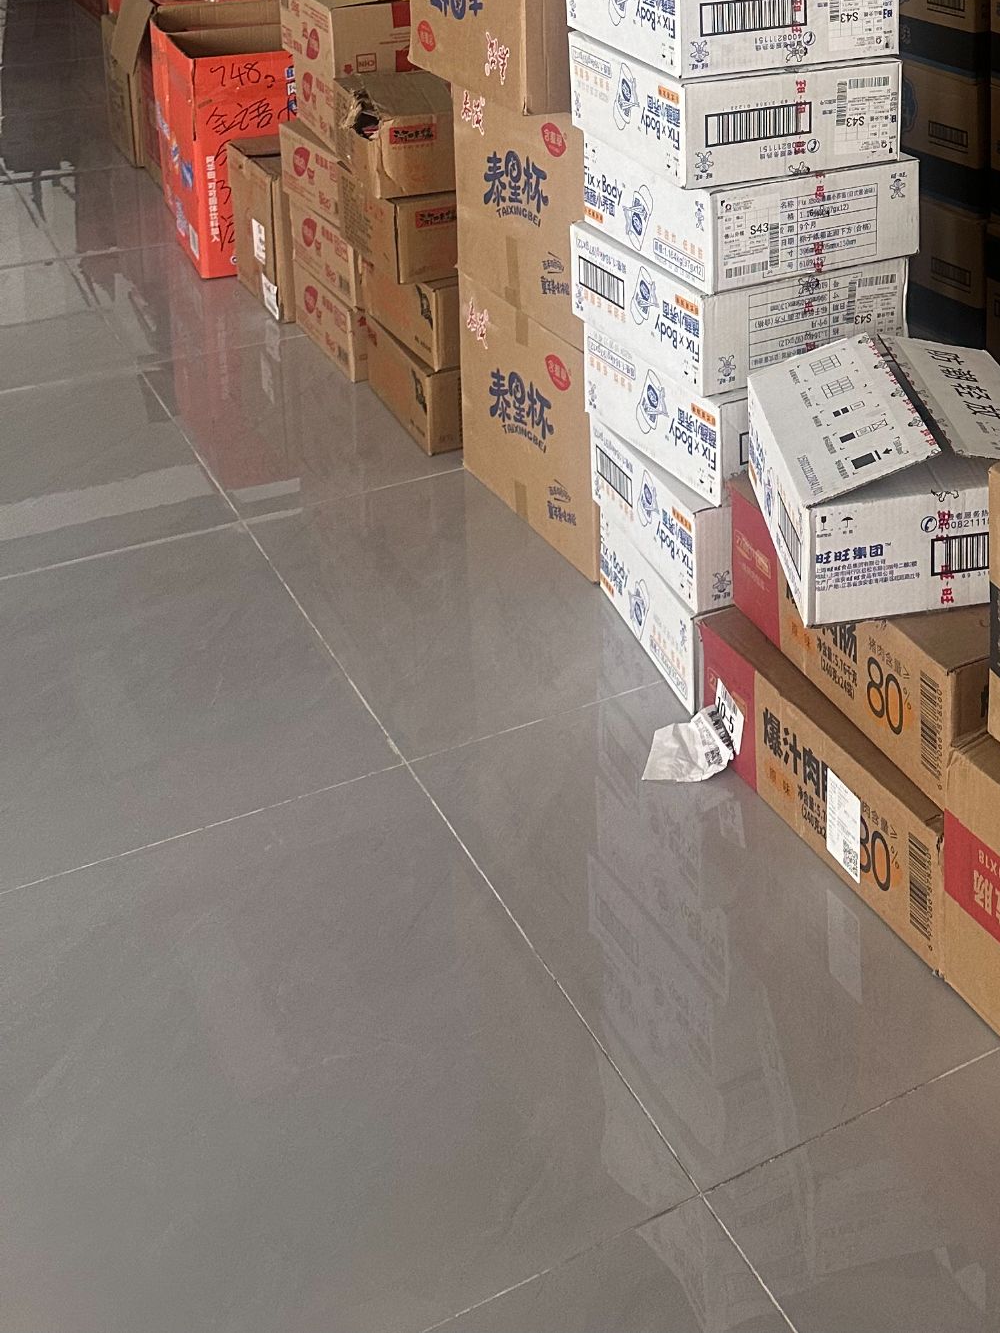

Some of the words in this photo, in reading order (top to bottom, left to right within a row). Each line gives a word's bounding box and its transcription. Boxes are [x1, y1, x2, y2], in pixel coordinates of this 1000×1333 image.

[841, 11, 858, 23] S43
[847, 116, 864, 127] S43
[484, 150, 549, 213] 泰星杯
[496, 208, 541, 227] TAIXINGBEI
[750, 223, 769, 236] S43
[855, 314, 872, 325] S43
[489, 367, 554, 442] 泰星杯
[501, 424, 547, 453] TAIXINGBEI
[816, 544, 883, 564] 旺旺集团
